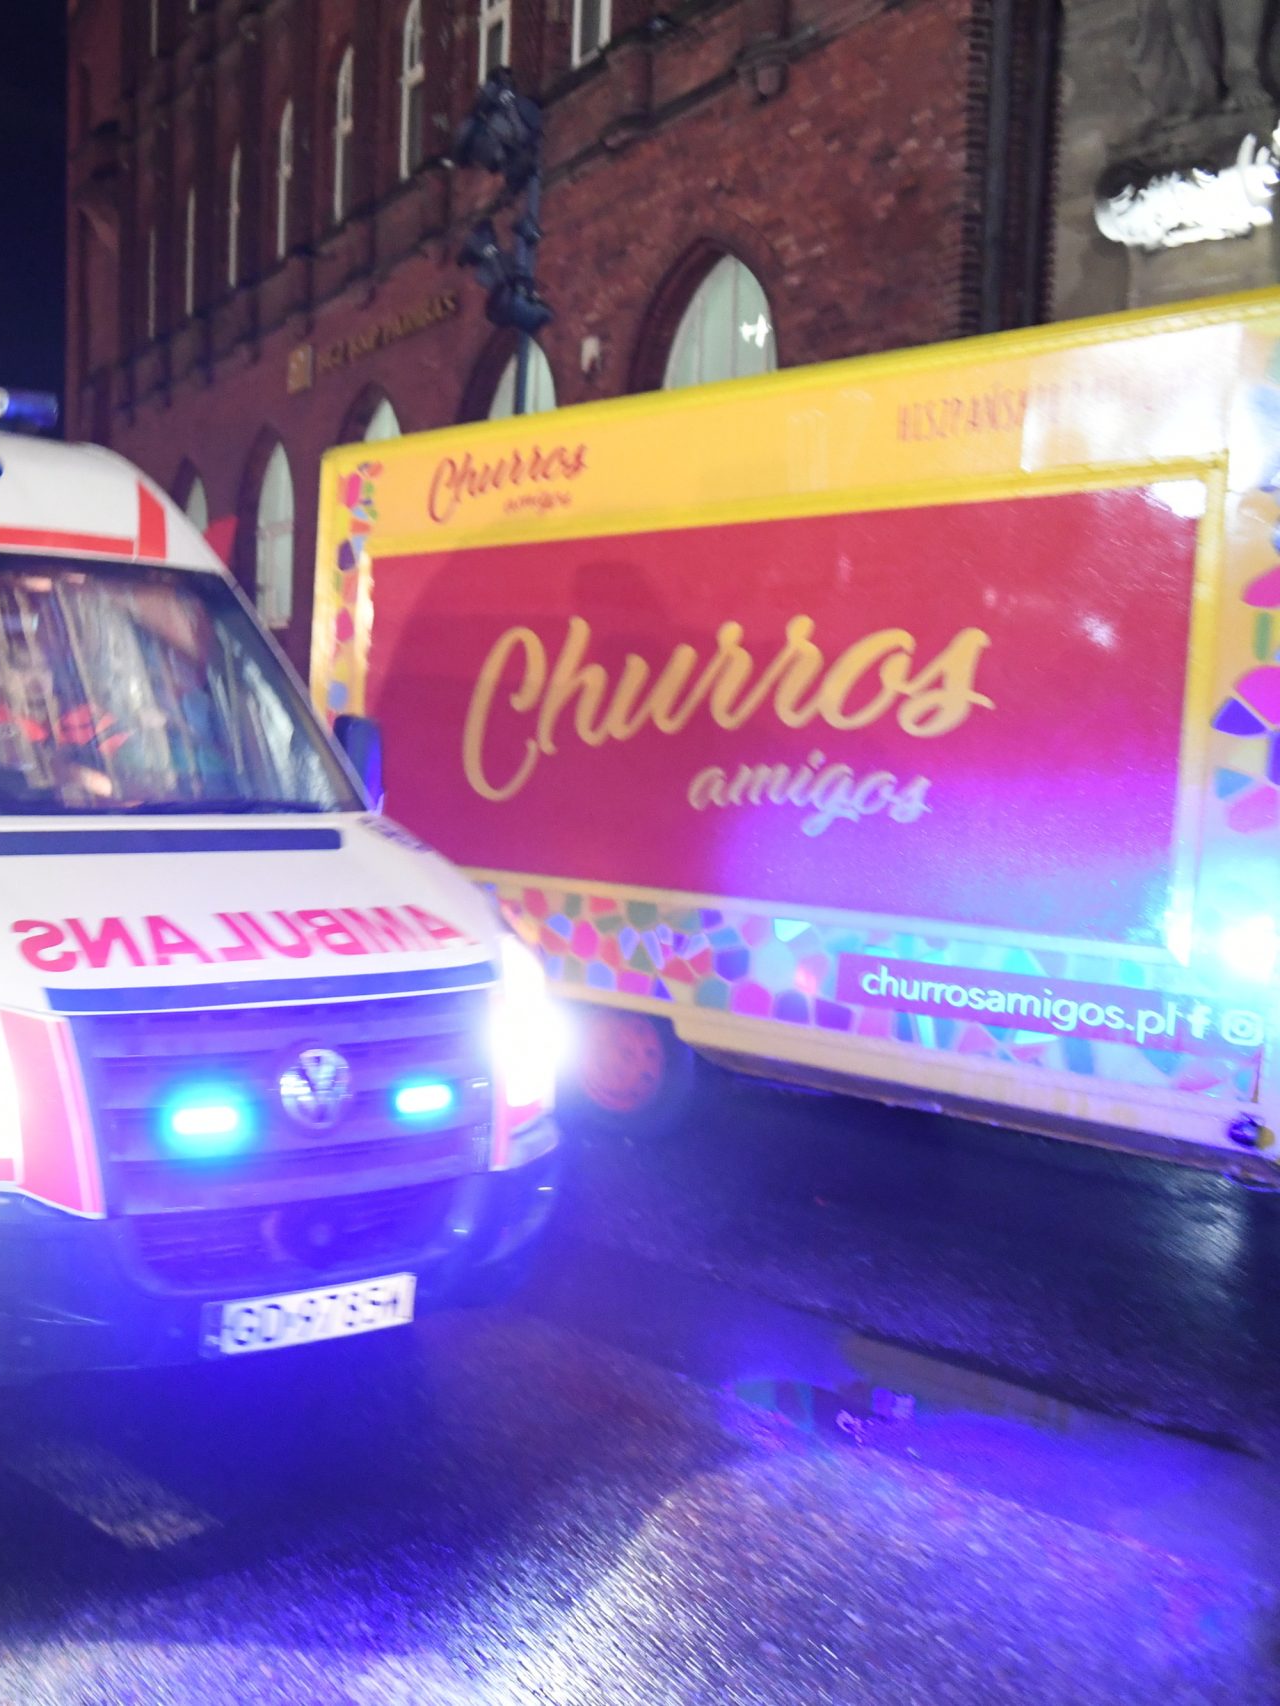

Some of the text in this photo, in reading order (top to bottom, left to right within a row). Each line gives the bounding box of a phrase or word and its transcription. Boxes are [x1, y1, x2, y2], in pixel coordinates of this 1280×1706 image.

[428, 443, 587, 523] Churros
[463, 615, 995, 801] Churros
[689, 750, 932, 837] amigos
[861, 965, 1176, 1044] churrosamigos.pl
